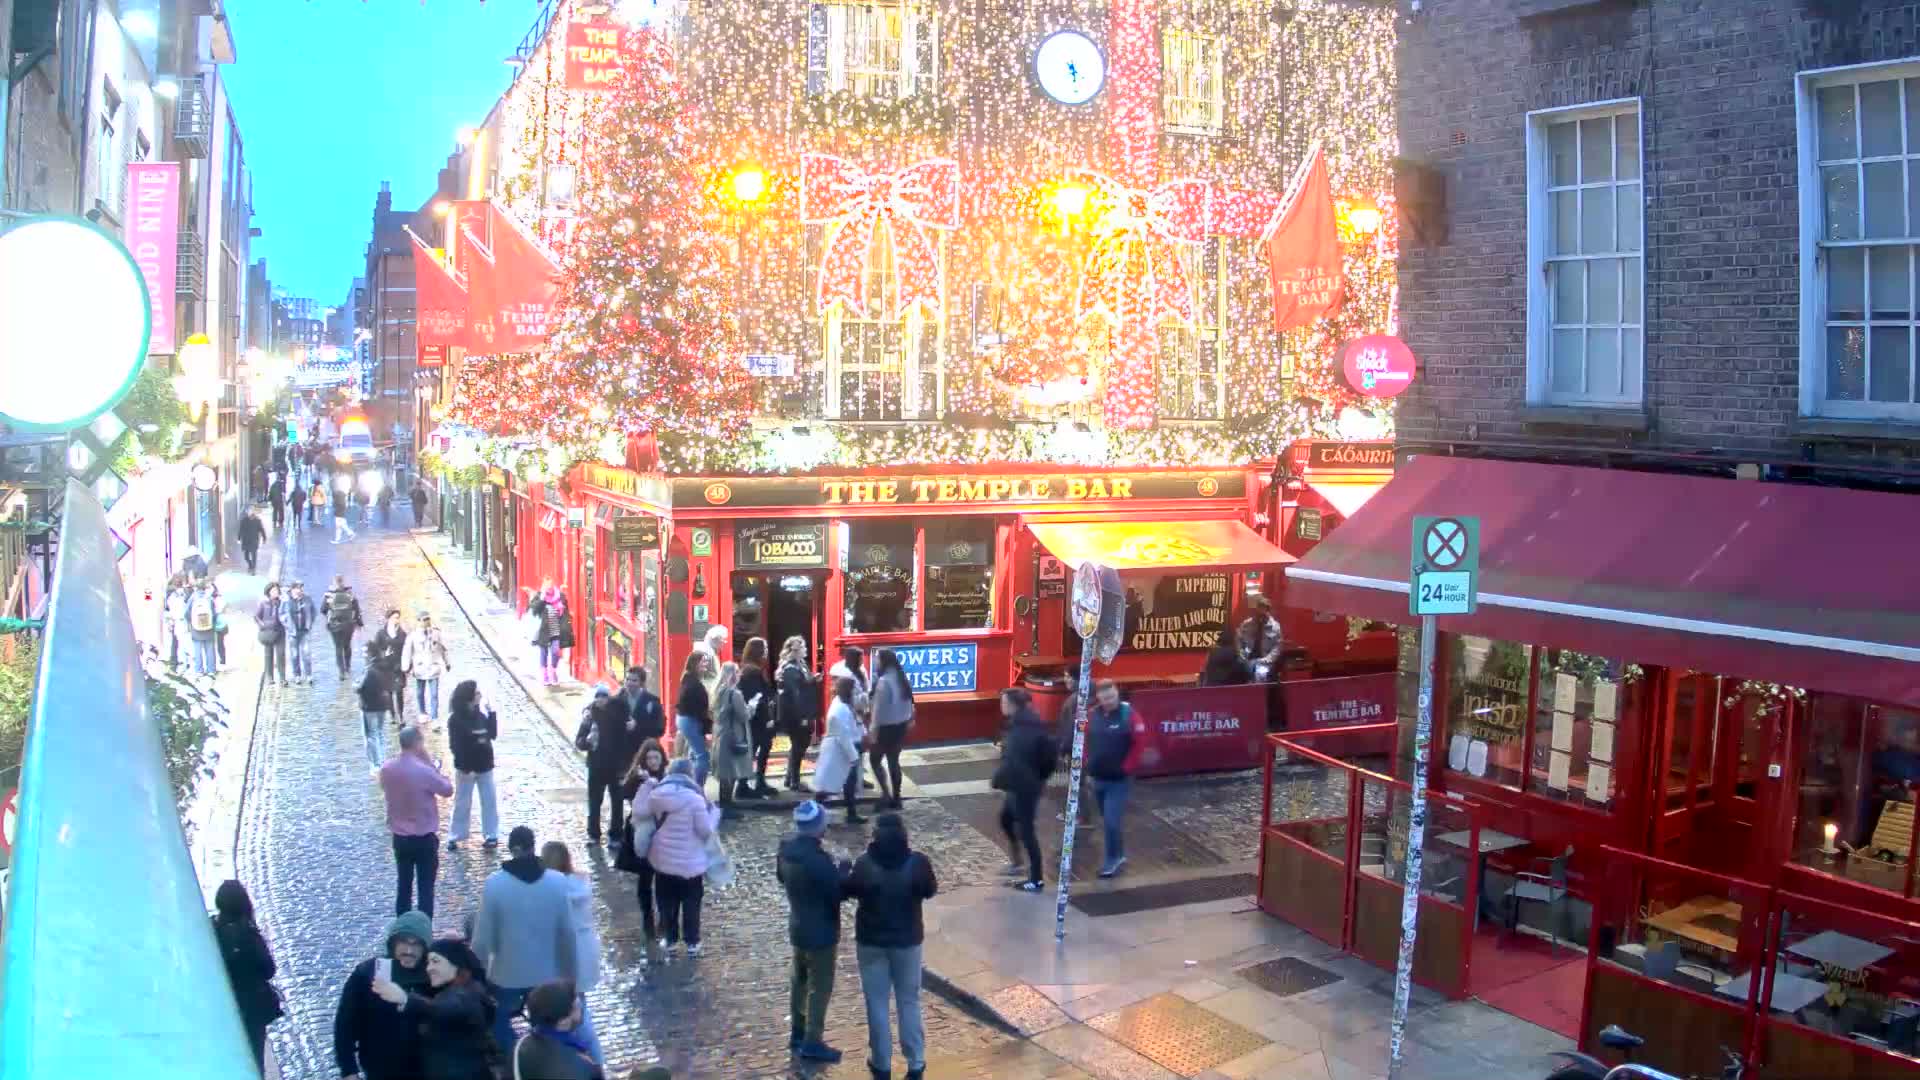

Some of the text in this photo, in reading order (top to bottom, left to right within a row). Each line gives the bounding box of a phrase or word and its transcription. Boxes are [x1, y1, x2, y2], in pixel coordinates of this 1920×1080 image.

[584, 28, 617, 44] THE
[137, 170, 169, 232] NINE
[1298, 267, 1325, 278] THE
[1278, 276, 1341, 294] TEMPLE
[1297, 292, 1330, 305] BAR
[520, 303, 544, 311] THE
[516, 325, 546, 335] BAR
[823, 477, 1132, 503] THE TEMPLE BAR
[749, 538, 816, 562] TOBACCO
[1176, 578, 1226, 593] EMPEROR
[1421, 583, 1443, 603] 24
[1212, 592, 1225, 607] OF
[1444, 593, 1466, 602] HOUR
[1138, 616, 1181, 632] MALTED
[895, 647, 969, 665] OWER'S
[906, 669, 973, 689] ISKEY
[1340, 699, 1357, 708] THE
[1192, 711, 1212, 720] THE
[1314, 704, 1382, 721] TEMPLE BAR
[1161, 717, 1240, 733] TEMPLE BAR
